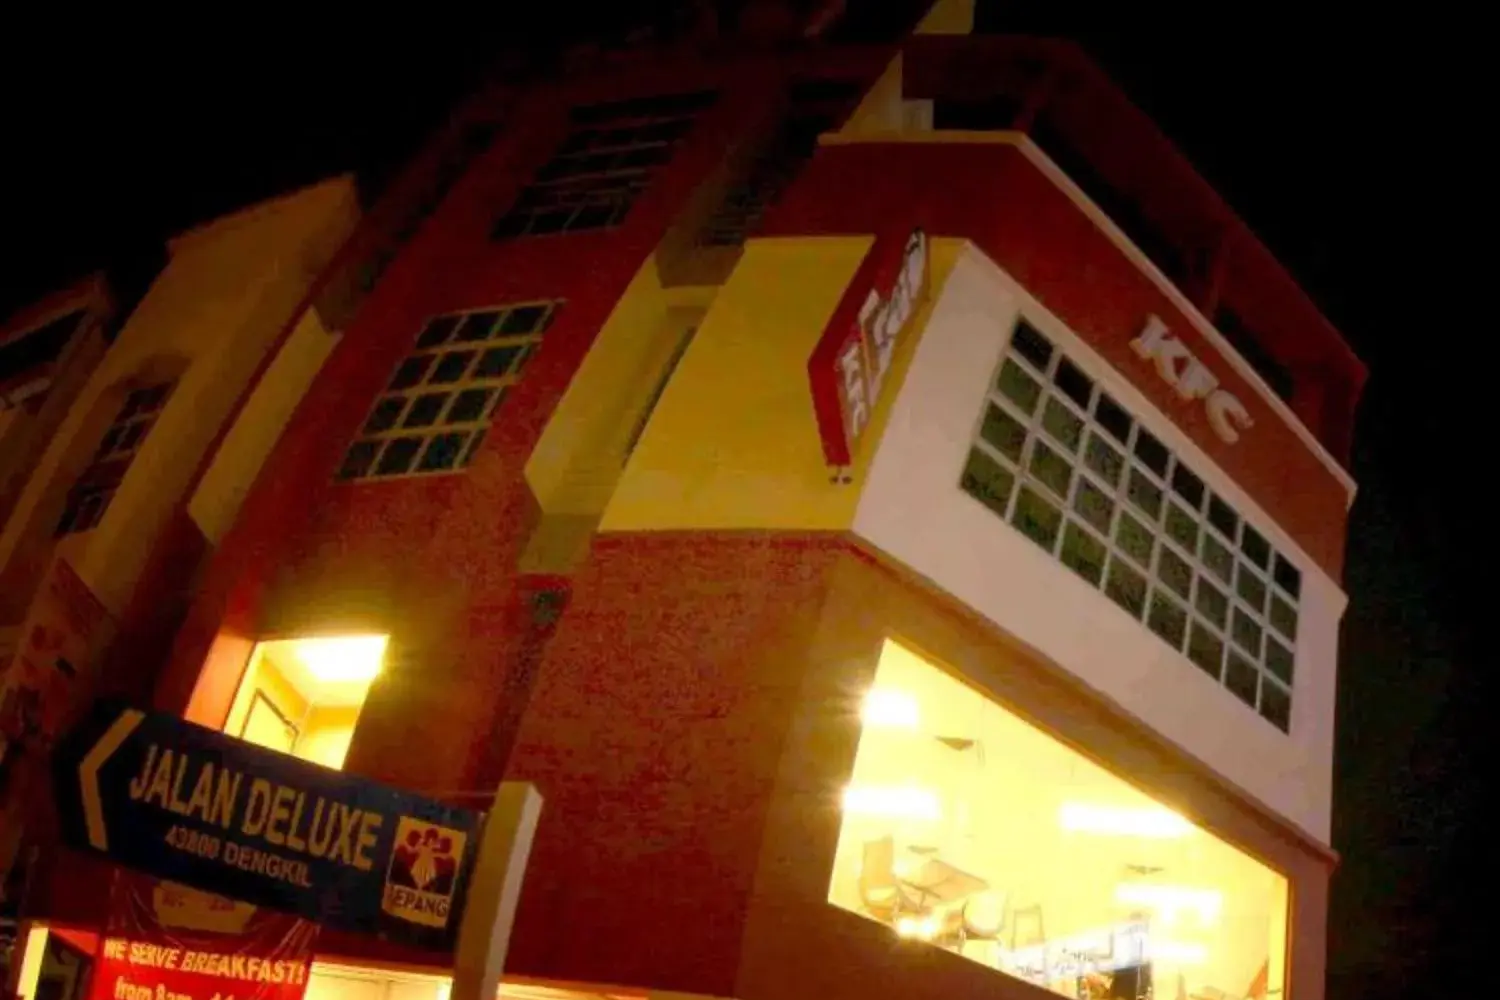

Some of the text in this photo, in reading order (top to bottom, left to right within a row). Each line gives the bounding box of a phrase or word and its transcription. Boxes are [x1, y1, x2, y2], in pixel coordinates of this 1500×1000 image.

[1129, 313, 1254, 444] KFC
[130, 745, 384, 871] JALAN DELUXE
[165, 824, 313, 888] 43800 DENGKIL
[104, 938, 127, 960] WE
[129, 940, 180, 970] SERVE
